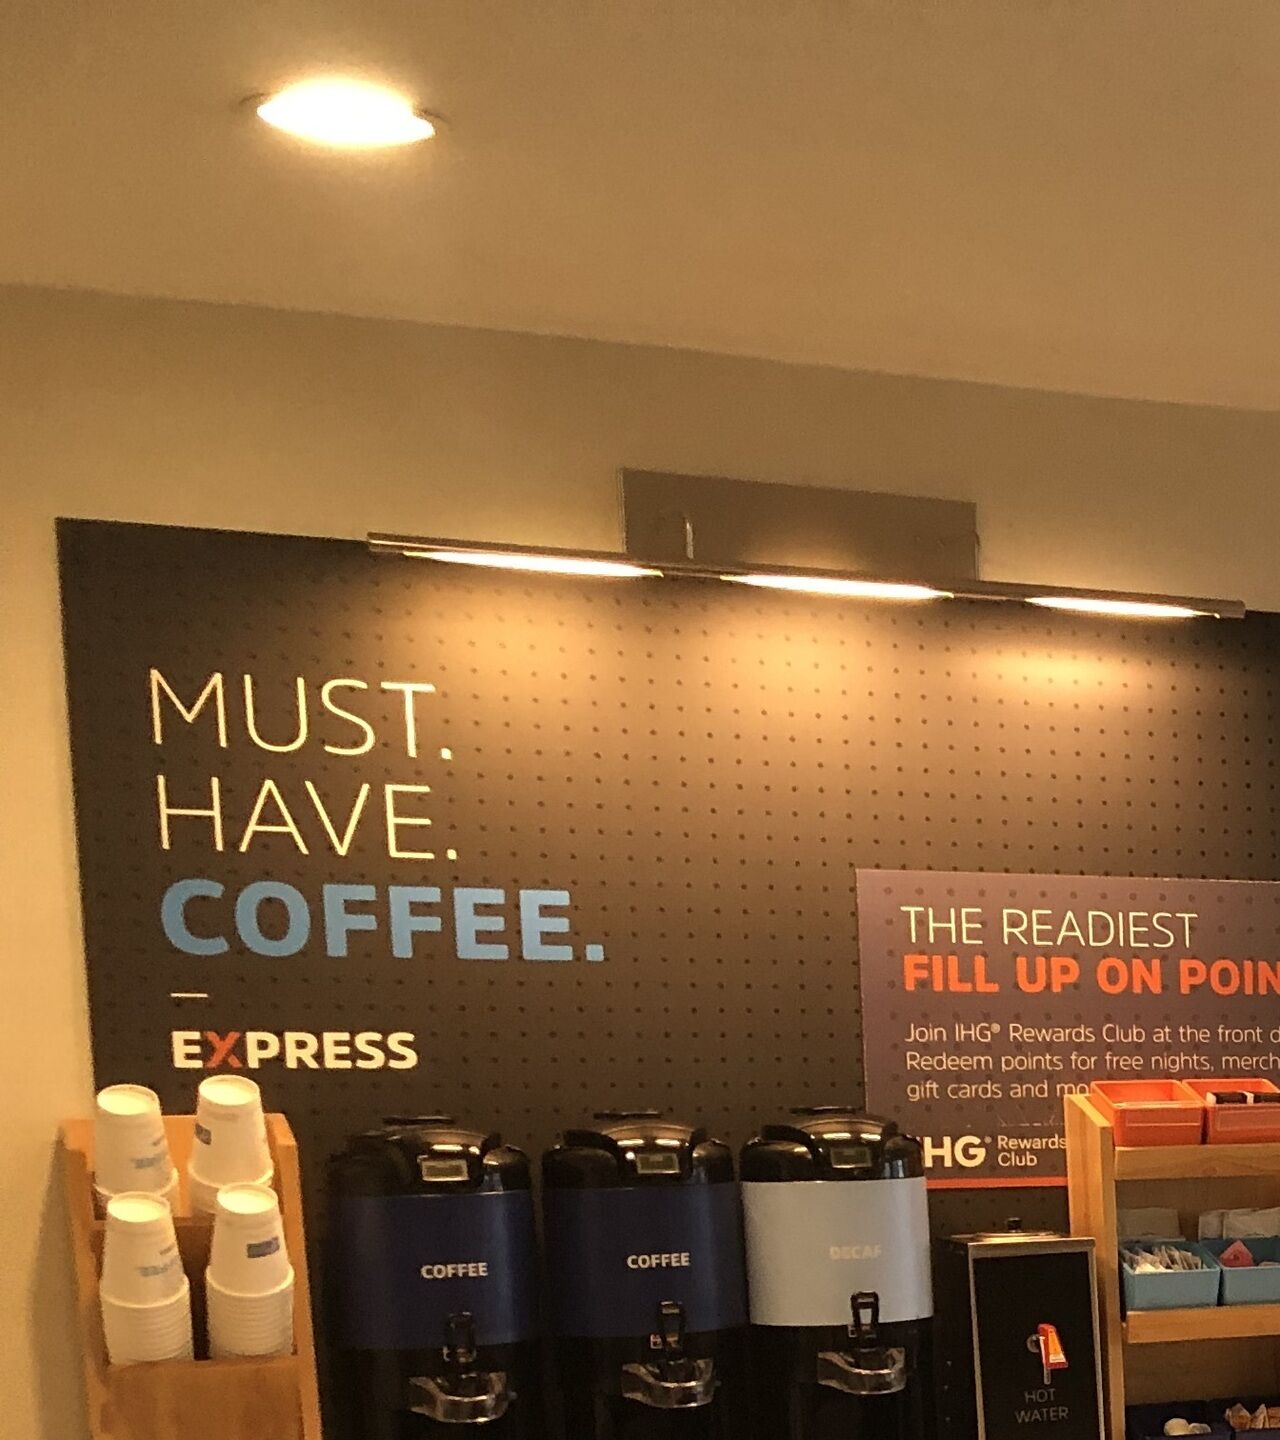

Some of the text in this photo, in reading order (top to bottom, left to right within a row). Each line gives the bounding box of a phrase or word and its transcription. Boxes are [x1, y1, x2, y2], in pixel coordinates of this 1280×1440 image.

[150, 667, 453, 760] MUST.
[156, 774, 458, 861] HAVE.
[160, 878, 605, 962] COFFEE.
[900, 906, 1198, 949] THE READIEST
[903, 954, 1000, 993] FILL
[1016, 956, 1080, 993] UP
[1096, 957, 1162, 995] ON
[904, 1023, 947, 1042] Join
[1009, 1023, 1096, 1042] Rewards
[1102, 1023, 1146, 1043] Club
[1153, 1026, 1172, 1043] at
[1179, 1025, 1211, 1043] the
[1218, 1024, 1263, 1043] front
[171, 1030, 419, 1070] EXPRESS
[905, 1051, 993, 1071] Redeem
[1001, 1052, 1063, 1073] points
[1070, 1051, 1099, 1070] for
[1105, 1051, 1143, 1070] free
[1151, 1052, 1215, 1073] nights,
[906, 1080, 940, 1101] gift
[947, 1080, 1002, 1099] cards
[1009, 1080, 1048, 1099] and
[997, 1133, 1068, 1150] Rewards
[997, 1151, 1038, 1167] Club
[626, 1252, 690, 1269] COFFEE
[829, 1244, 882, 1260] DECAF
[420, 1262, 489, 1279] COFFEE
[1024, 1388, 1056, 1403] HOT
[1014, 1406, 1069, 1424] WATER
